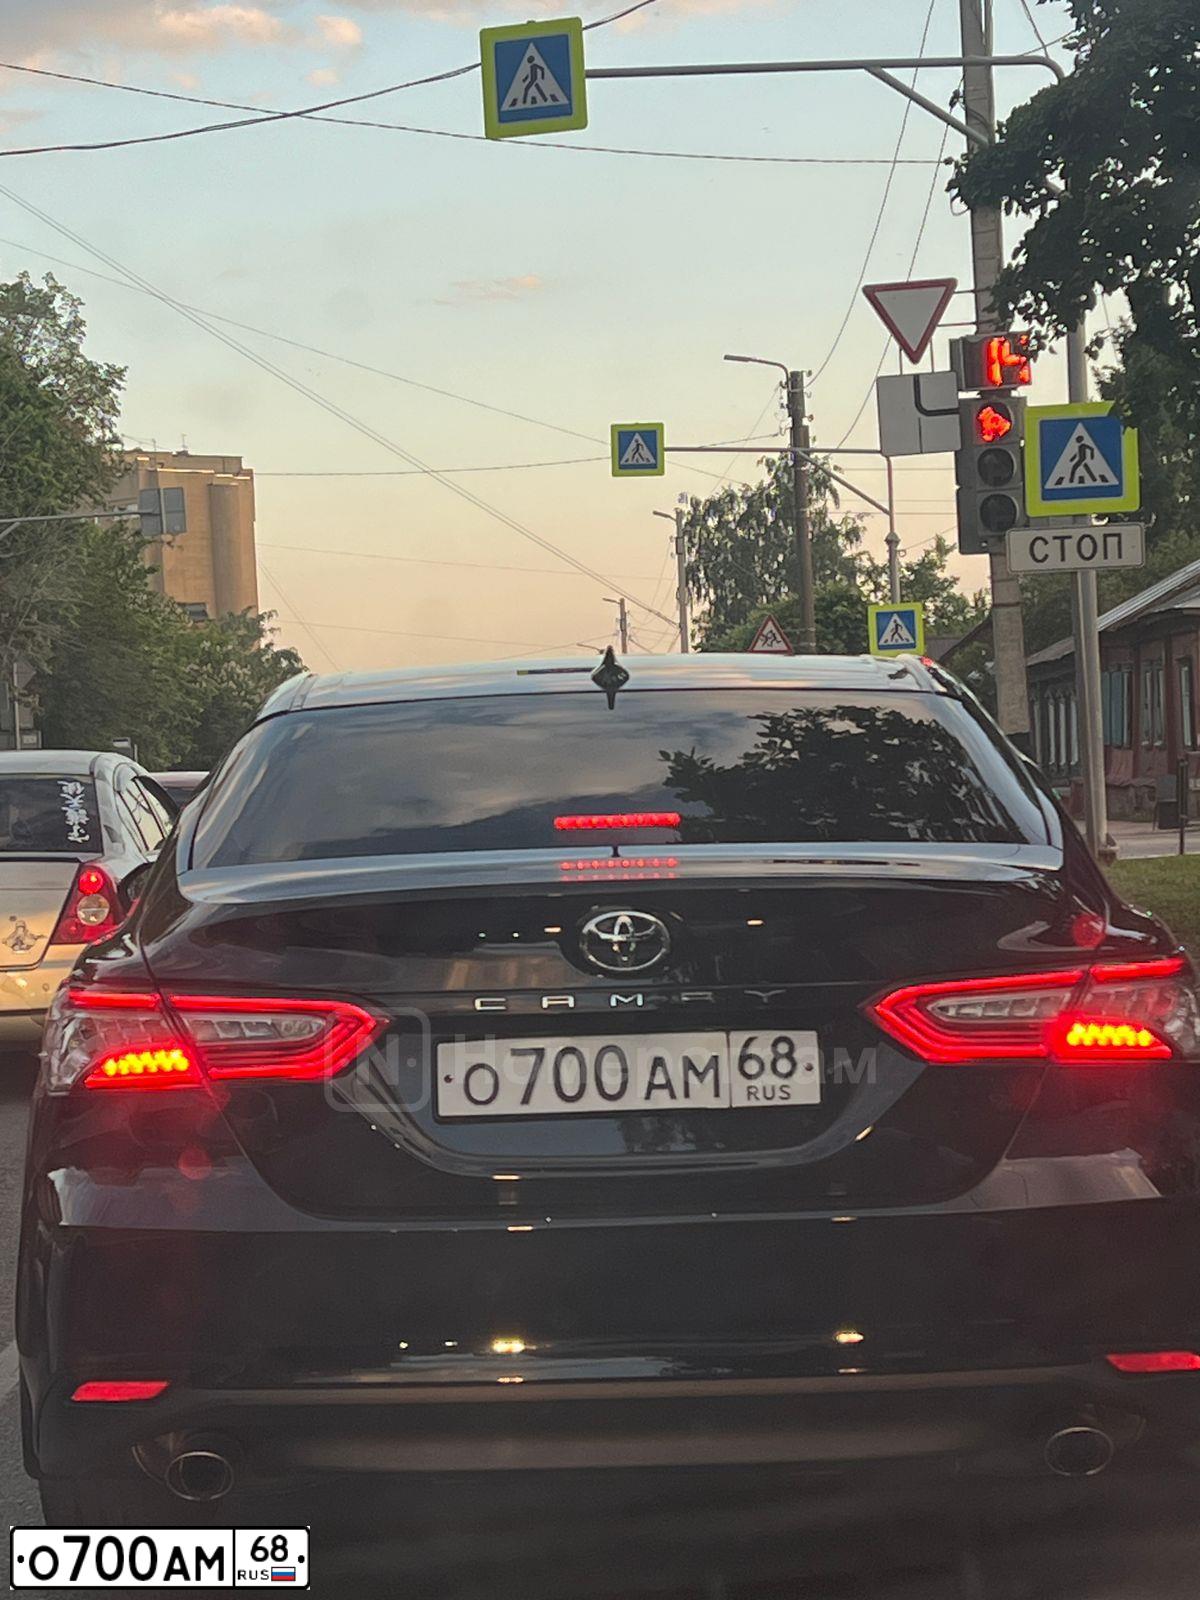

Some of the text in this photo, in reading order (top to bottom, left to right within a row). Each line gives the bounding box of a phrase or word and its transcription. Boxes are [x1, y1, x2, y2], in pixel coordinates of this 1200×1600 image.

[1029, 533, 1123, 564] СТОП
[474, 988, 787, 1011] CAMRY
[738, 1035, 798, 1080] 68
[463, 1043, 722, 1107] О700АМ
[746, 1083, 792, 1102] RUS
